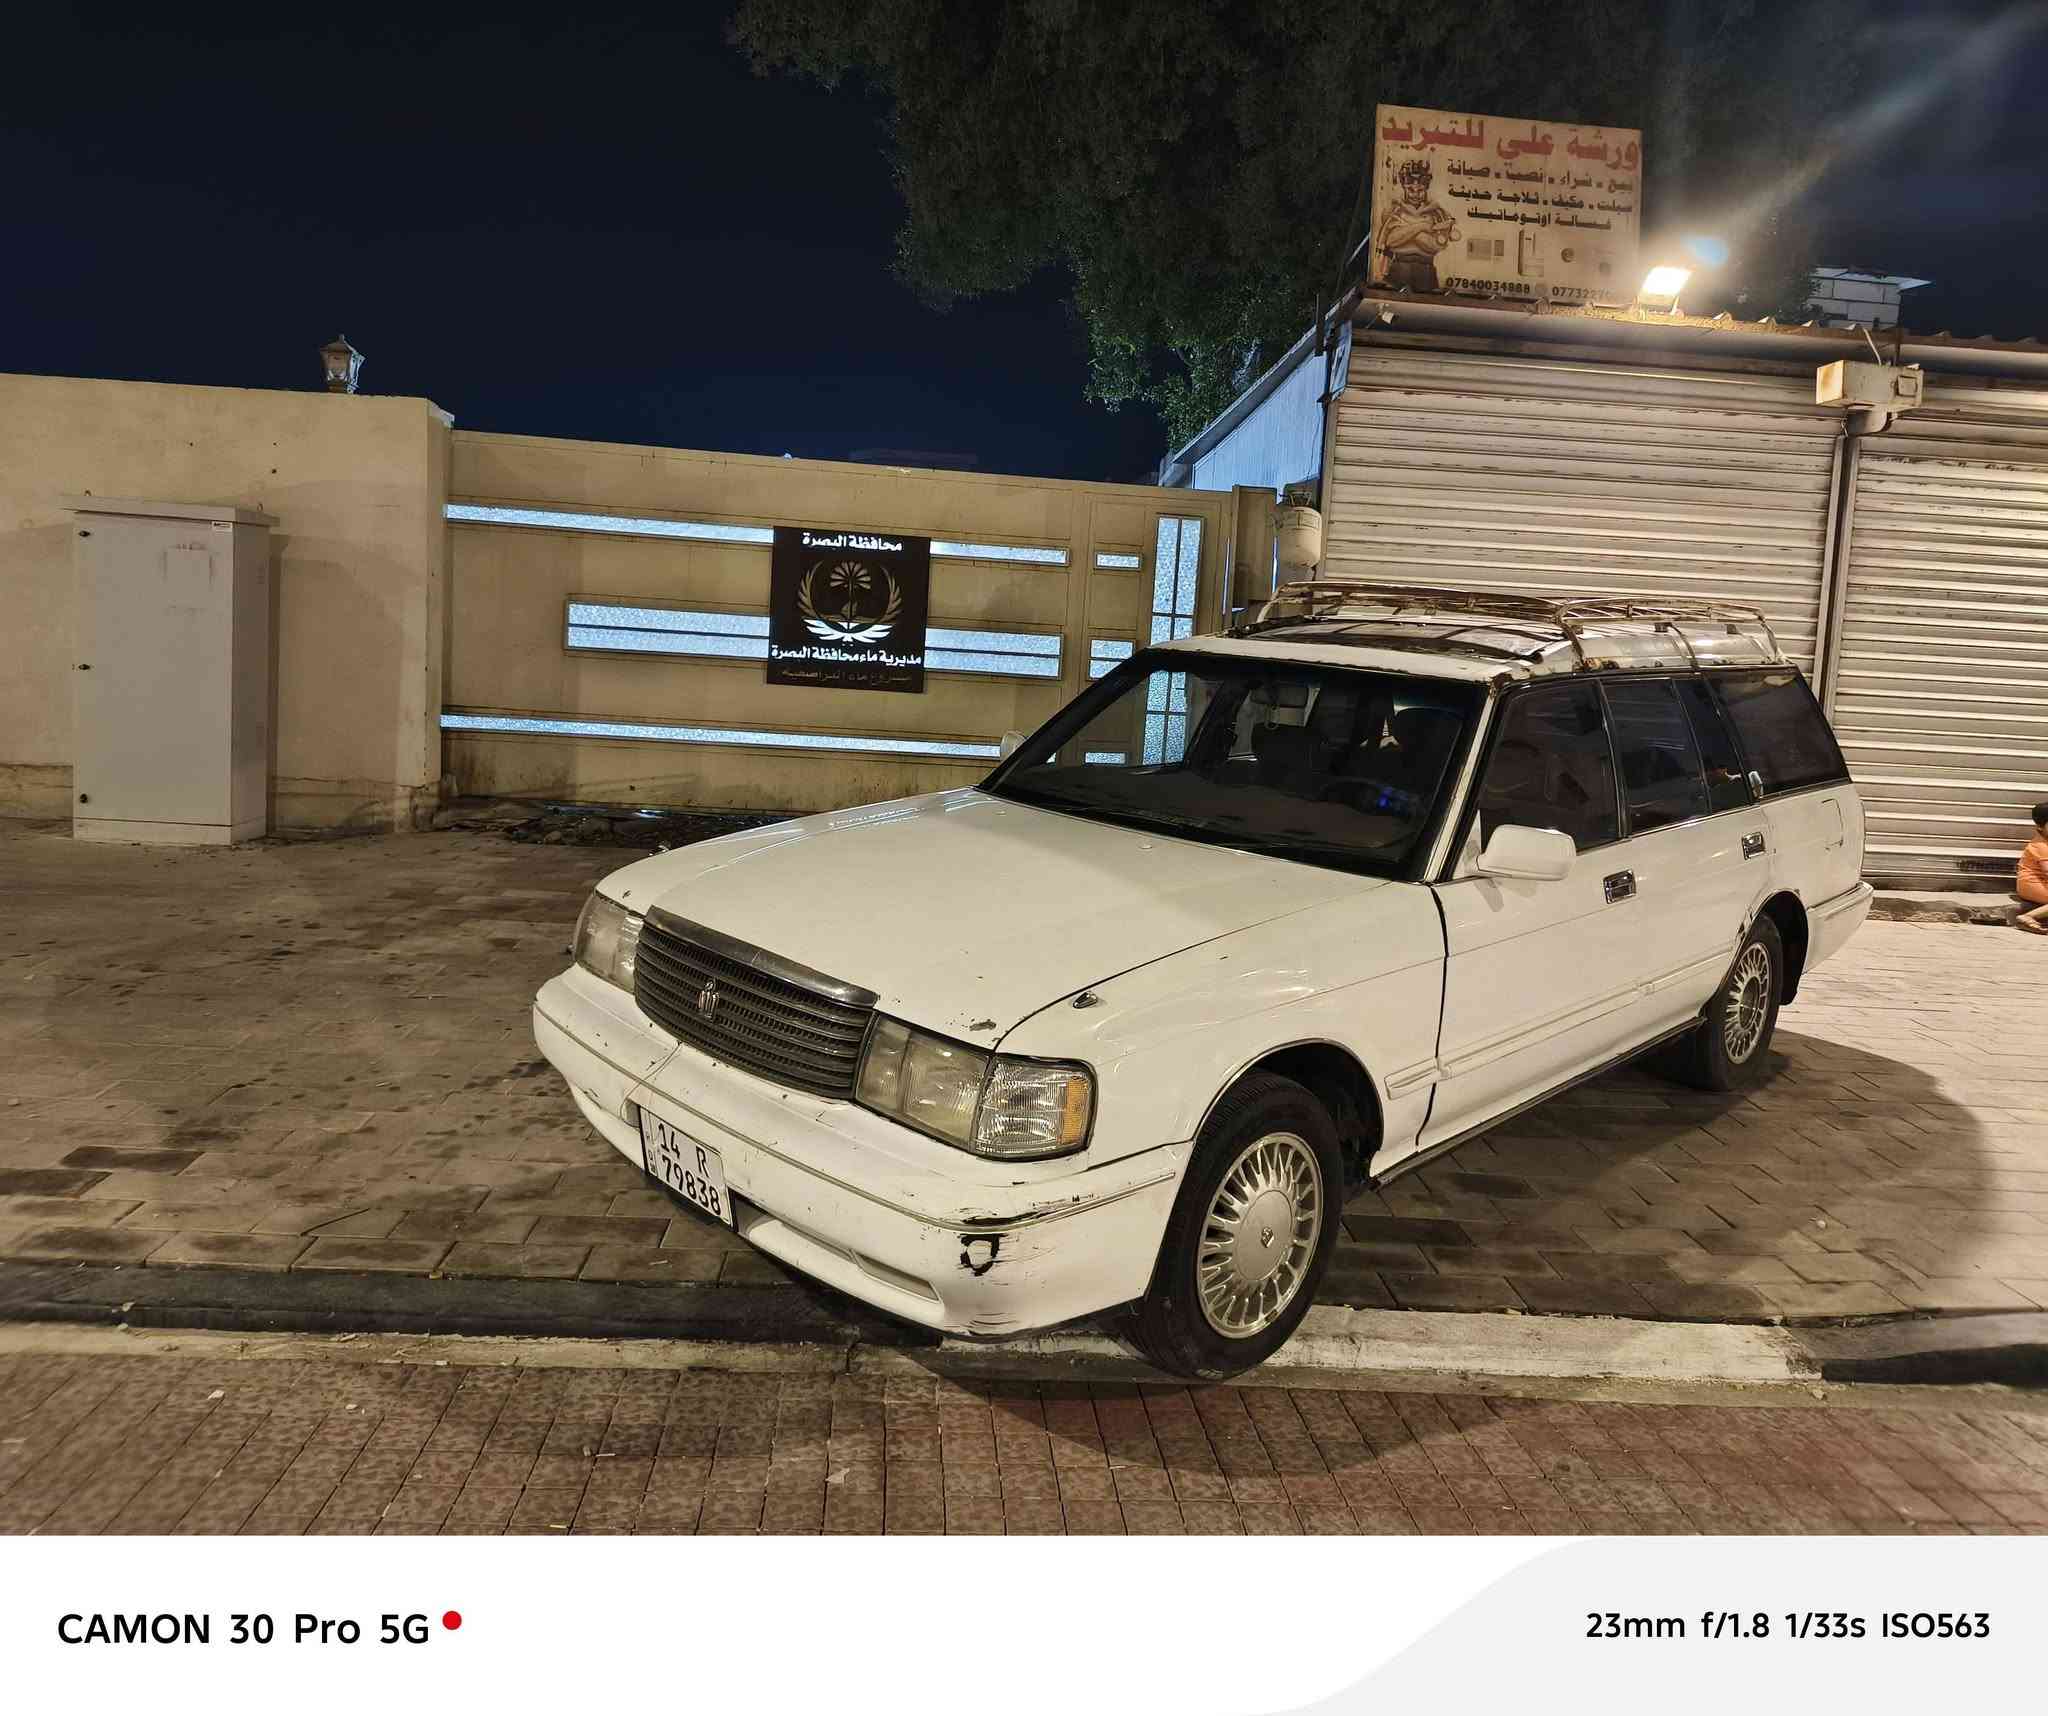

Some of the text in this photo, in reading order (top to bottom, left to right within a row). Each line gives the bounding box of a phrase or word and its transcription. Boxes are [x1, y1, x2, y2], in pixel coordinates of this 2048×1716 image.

[1382, 116, 1641, 169] ورشة علي للتبريد
[1446, 158, 1491, 179] صيانة
[1506, 170, 1545, 183] نصب
[1447, 183, 1492, 202] حديثة
[802, 532, 903, 552] محافظة البصرة
[771, 645, 922, 667] مديرية ماء محافظة البصرة
[658, 1122, 681, 1159] 14
[695, 1144, 709, 1178] R
[662, 1154, 721, 1216] 79838
